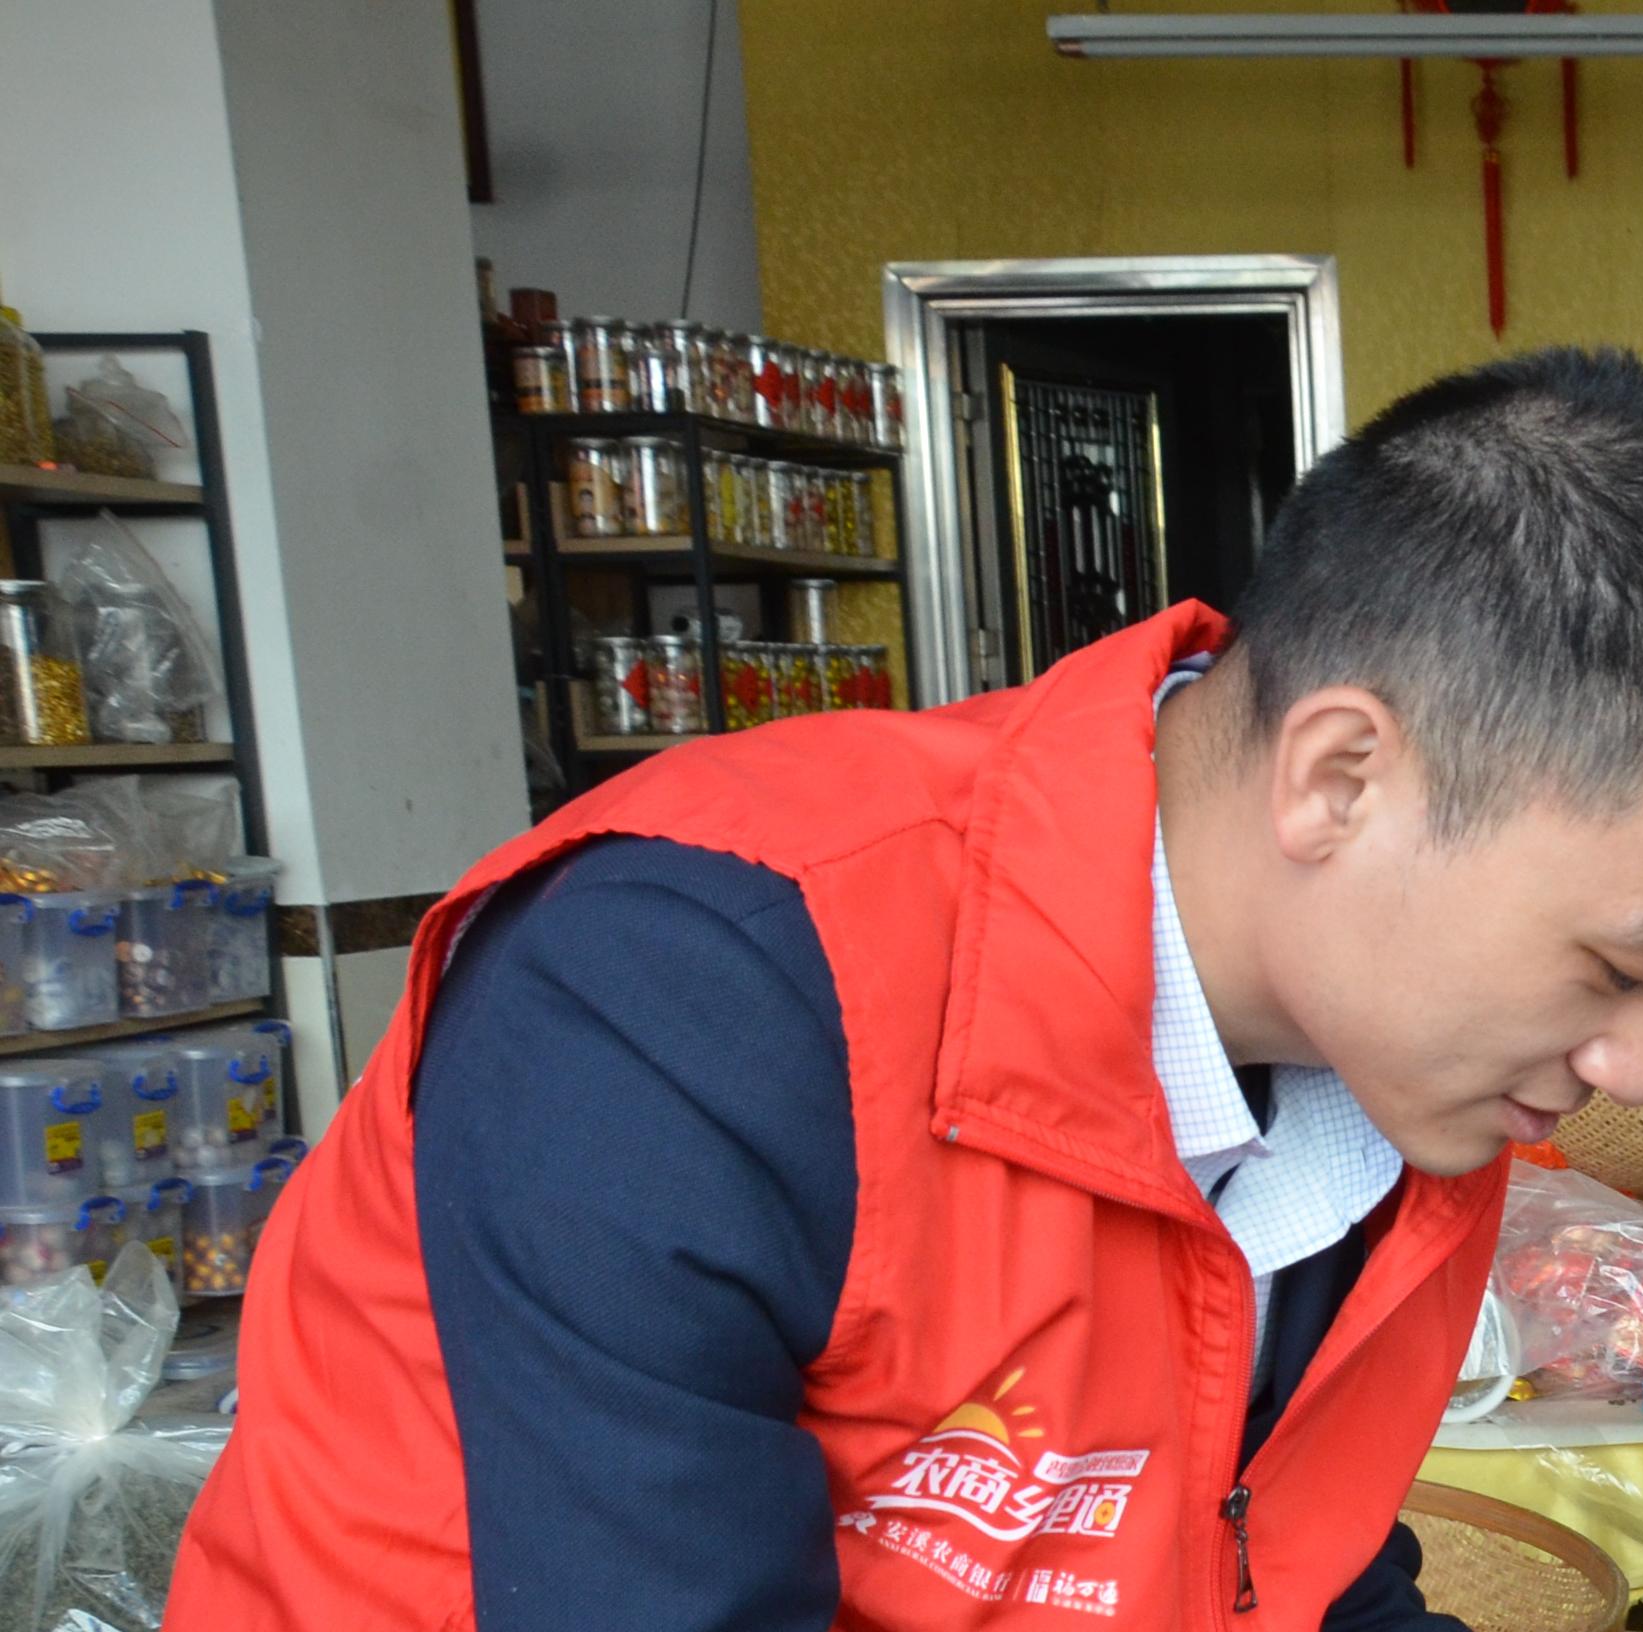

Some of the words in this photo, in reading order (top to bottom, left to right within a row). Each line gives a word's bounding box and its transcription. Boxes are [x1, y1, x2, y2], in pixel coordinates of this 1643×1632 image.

[891, 1447, 1134, 1539] 农商乡里通
[884, 1519, 1012, 1593] 安溪农商银行
[1052, 1571, 1119, 1605] 福万通
